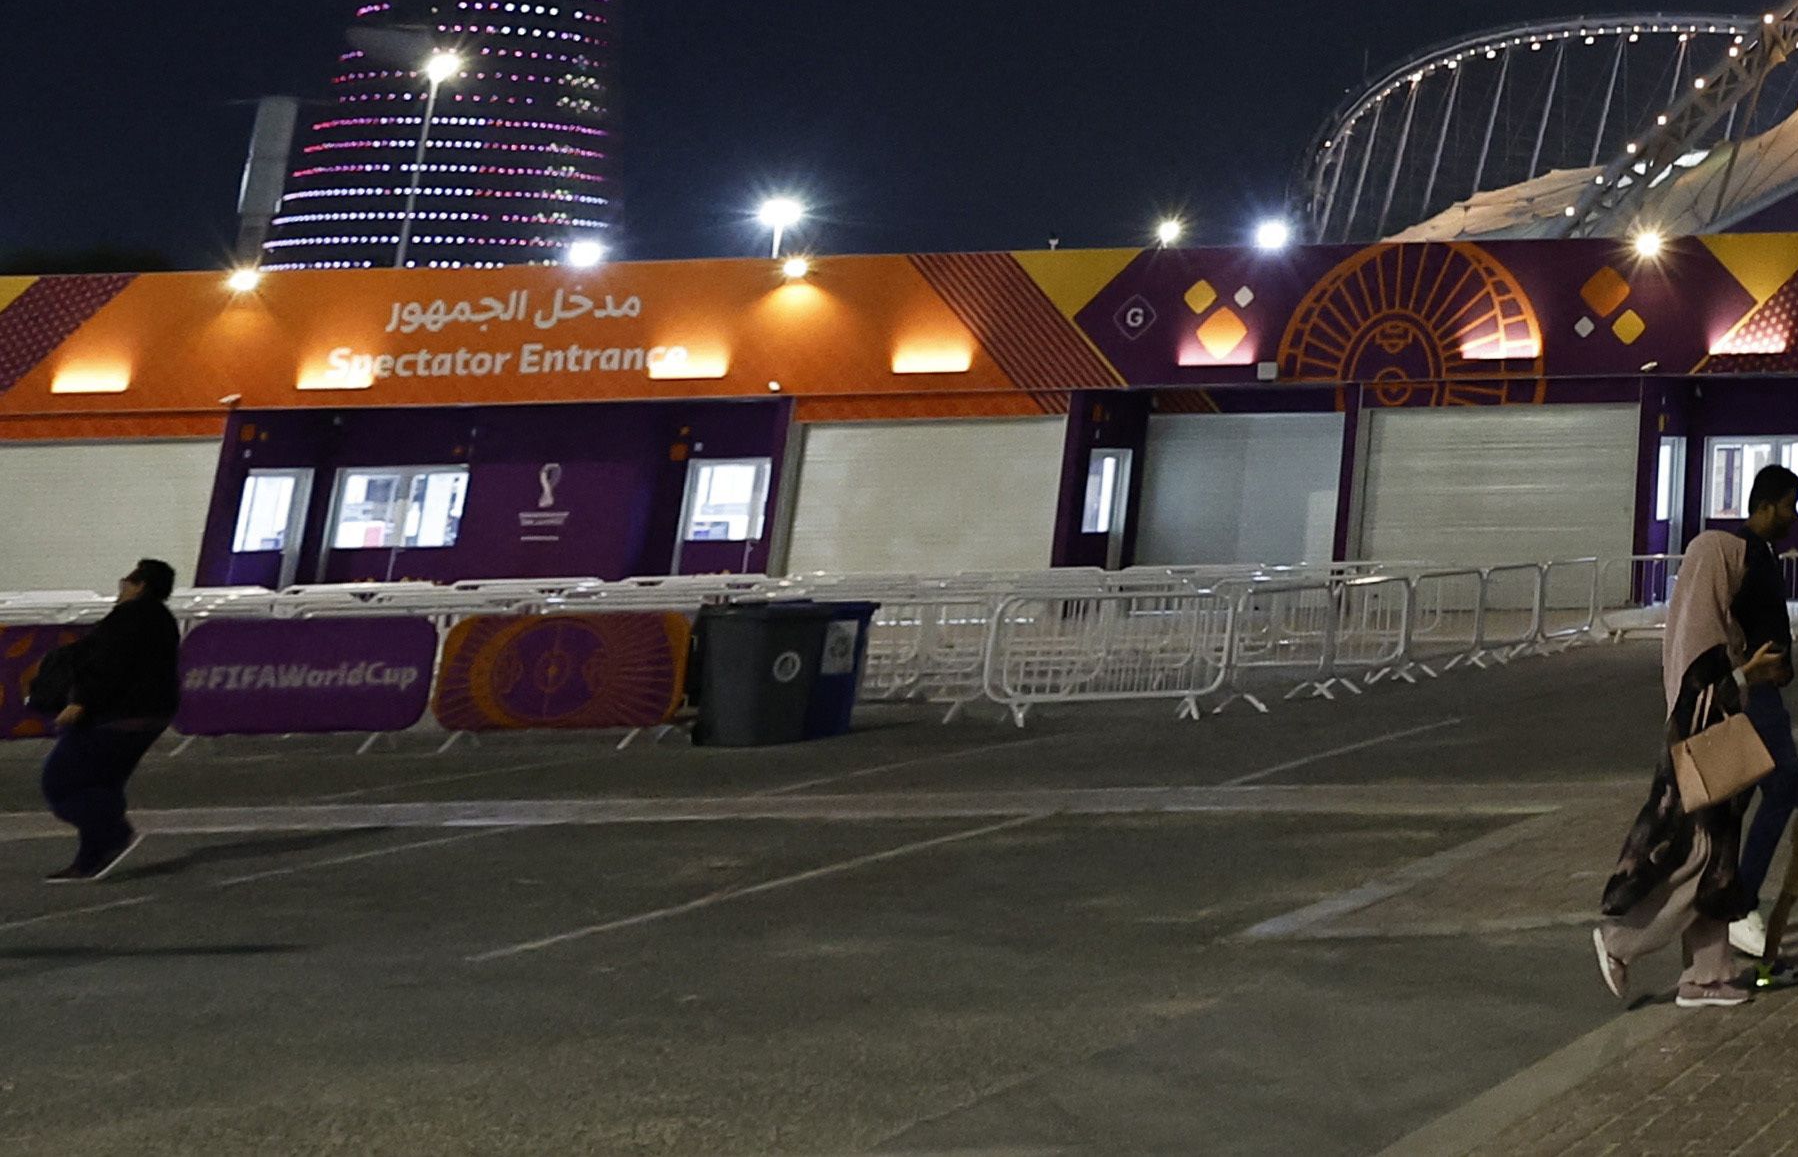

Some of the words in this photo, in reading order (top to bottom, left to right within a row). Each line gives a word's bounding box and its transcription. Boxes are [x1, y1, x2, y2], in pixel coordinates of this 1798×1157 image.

[385, 289, 528, 333] الجمهور
[534, 286, 642, 330] مدخل
[1126, 308, 1143, 326] G
[325, 345, 510, 380] Spectator
[184, 661, 418, 691] #FIFAWorldCup
